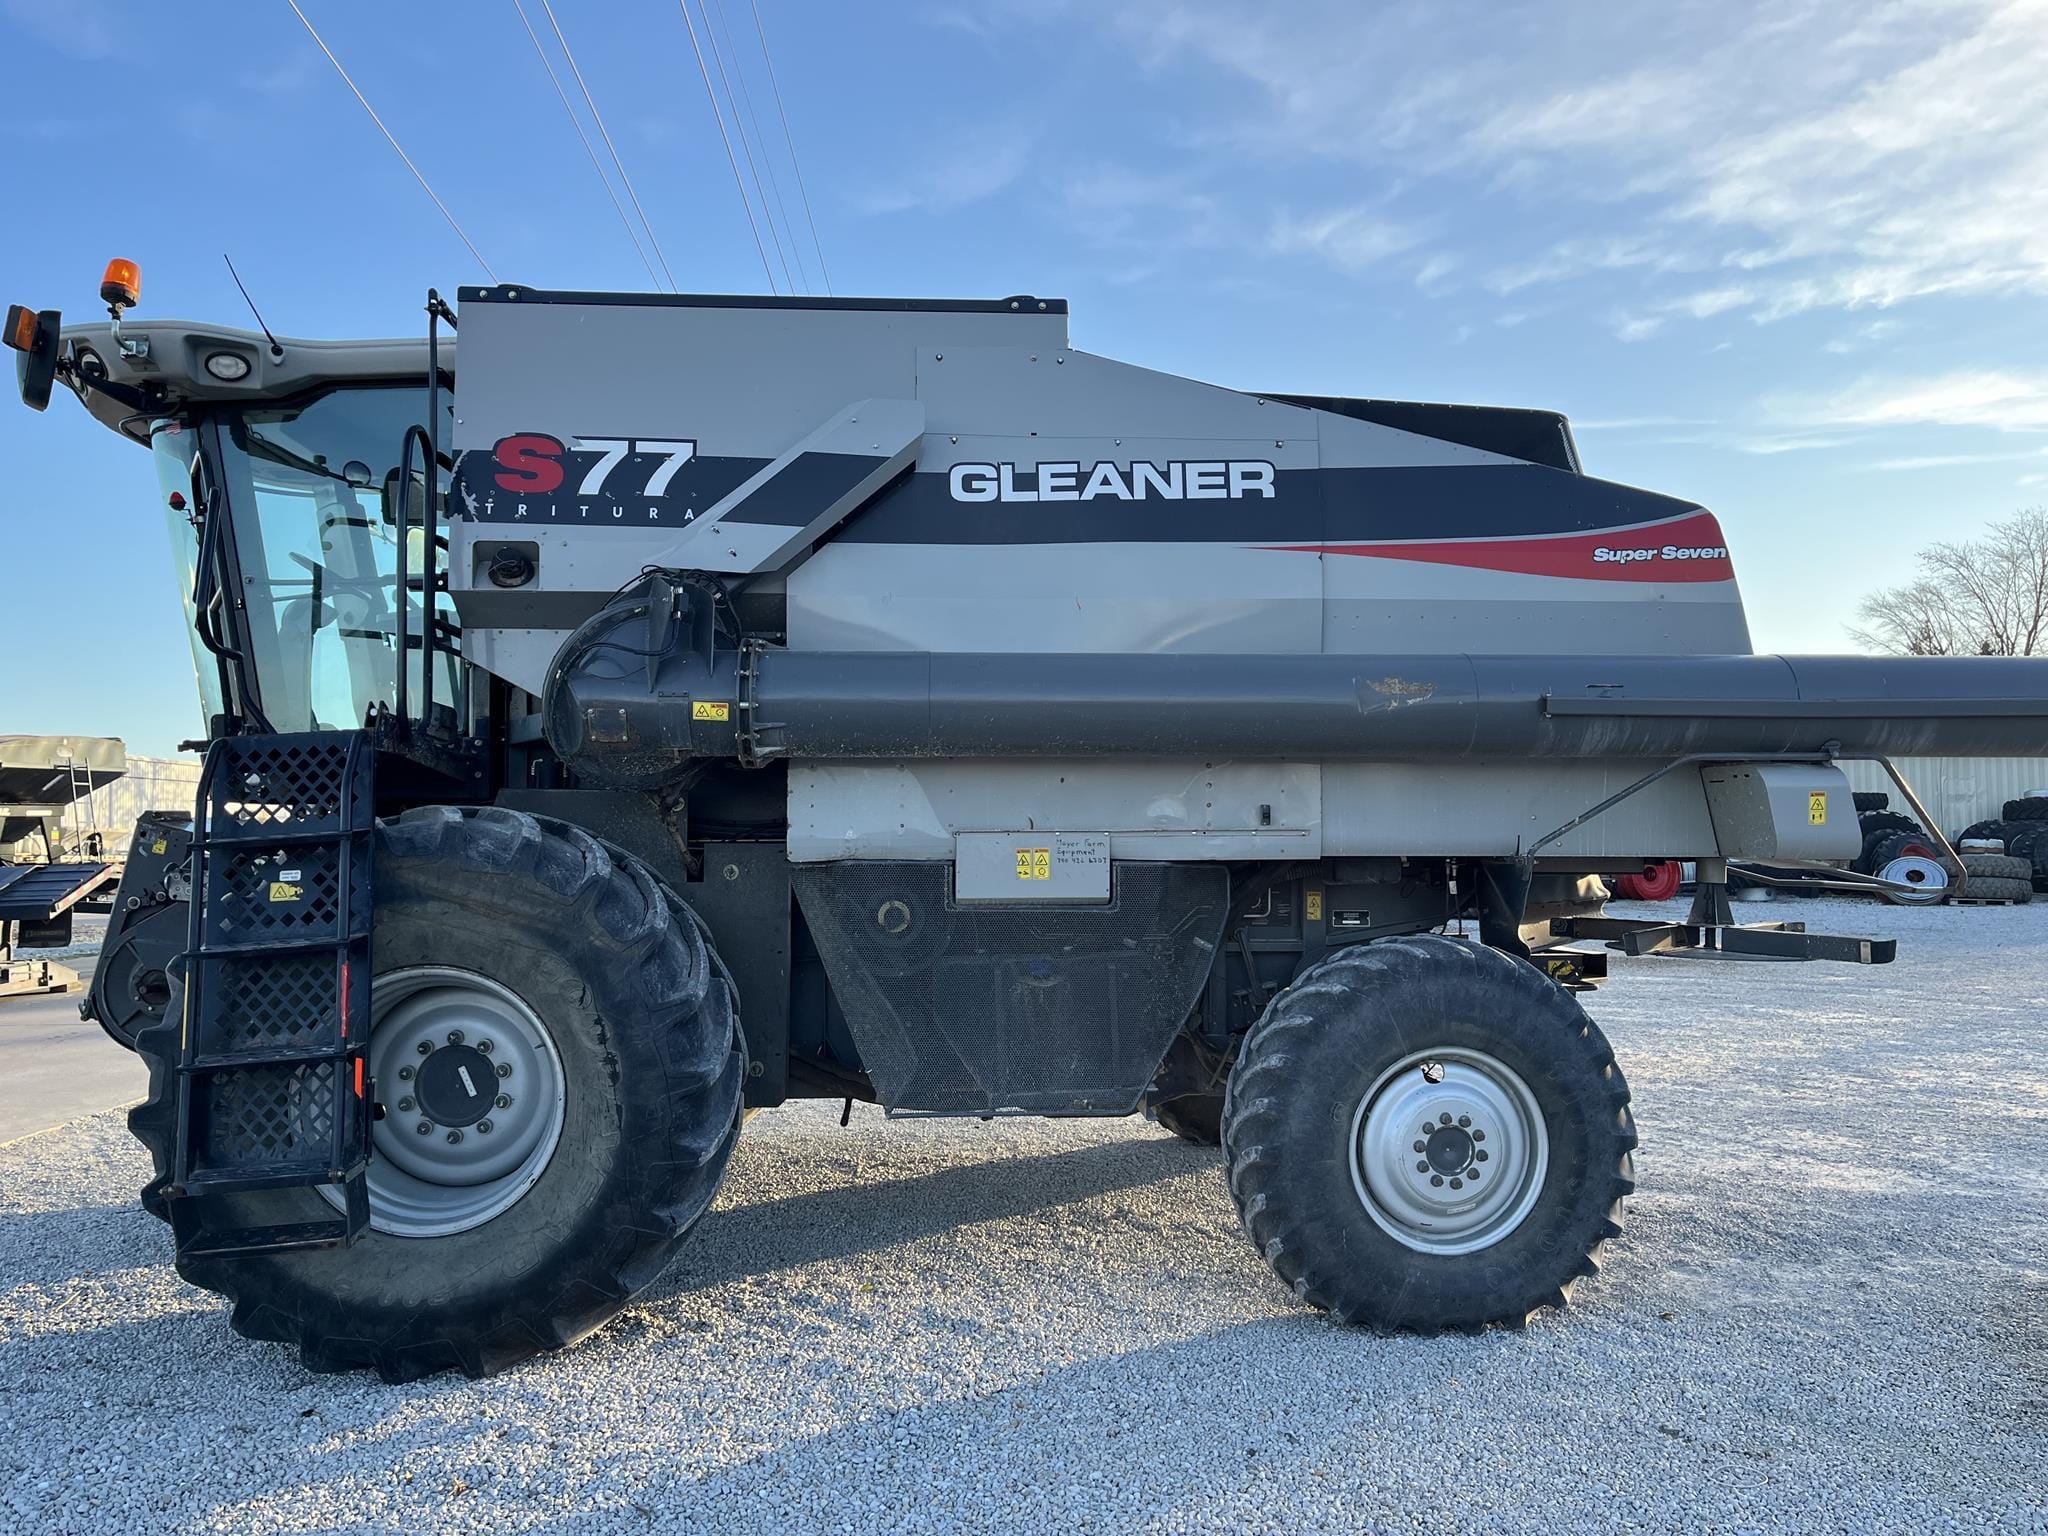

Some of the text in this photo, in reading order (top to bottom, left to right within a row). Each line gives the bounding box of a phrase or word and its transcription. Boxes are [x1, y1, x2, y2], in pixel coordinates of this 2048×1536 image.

[493, 433, 697, 497] S77
[949, 461, 1276, 503] GLEANER
[485, 503, 696, 520] TRITURA
[1593, 545, 1727, 564] Super Seven
